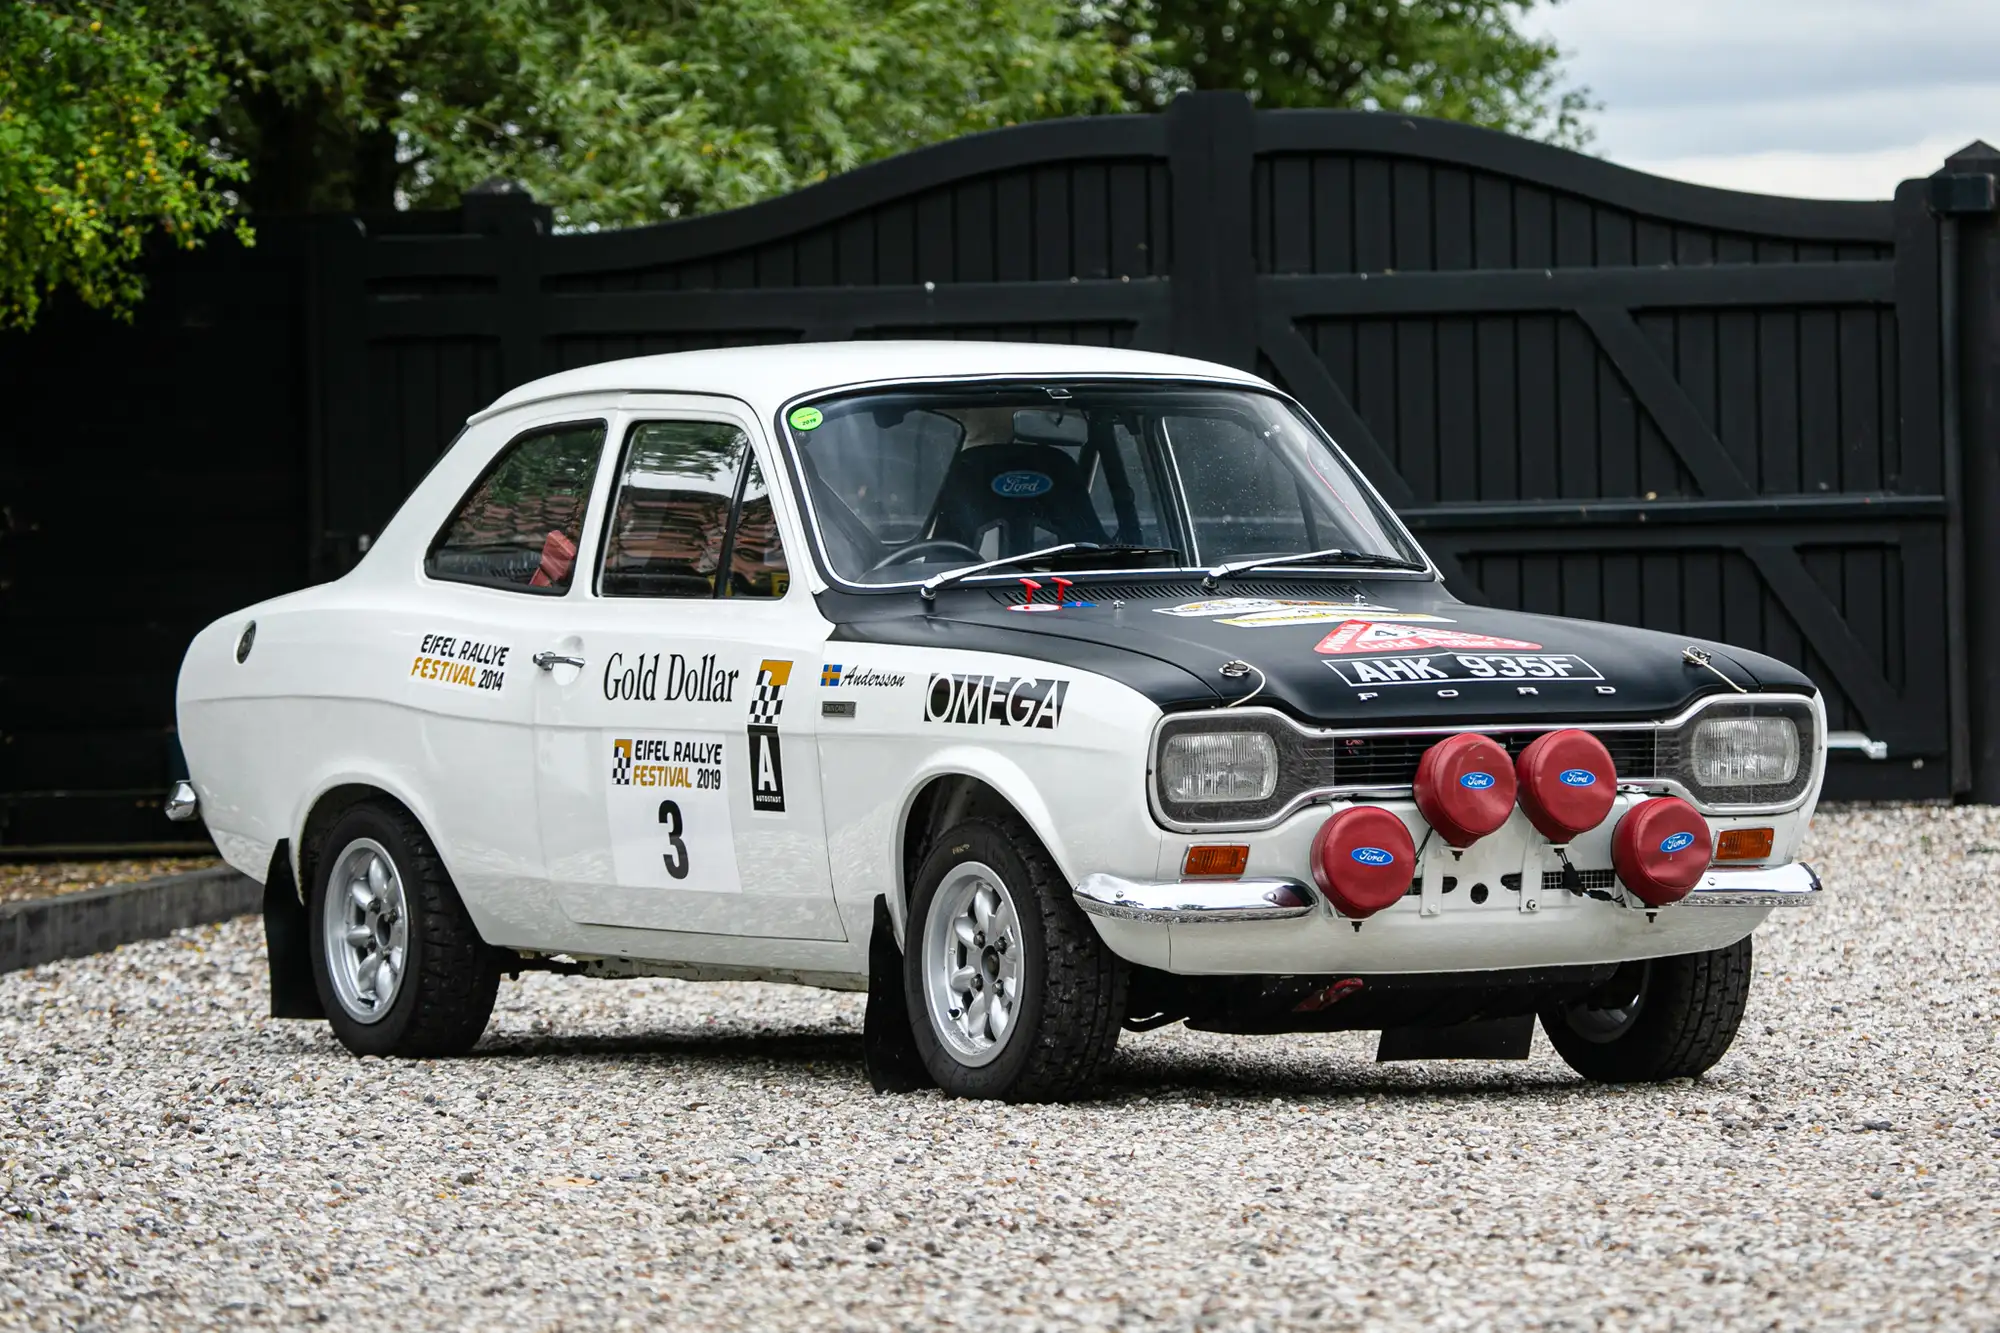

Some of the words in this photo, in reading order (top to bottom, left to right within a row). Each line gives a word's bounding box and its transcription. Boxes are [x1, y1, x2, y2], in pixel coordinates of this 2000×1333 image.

[1003, 475, 1040, 492] Ford
[420, 633, 456, 657] EIFEL
[459, 640, 510, 667] RALLYE
[411, 657, 476, 688] FESTIVAL
[477, 671, 504, 692] 2014
[604, 652, 659, 702] Gold
[664, 652, 740, 703] Dollar
[840, 664, 905, 688] Andersson
[1351, 658, 1449, 683] AHK
[1456, 655, 1574, 678] 935F
[924, 672, 1070, 730] OMEGA
[635, 740, 670, 762] EIFEL
[673, 741, 723, 765] RALLYE
[758, 734, 778, 792] A
[632, 764, 692, 789] FESTIVAL
[696, 768, 722, 791] 2019
[1467, 772, 1489, 788] Ford
[1566, 769, 1590, 785] Ford
[755, 795, 782, 803] AUTOSTADT
[658, 799, 690, 880] 3
[1668, 833, 1689, 851] Ford
[1358, 848, 1387, 864] Ford
